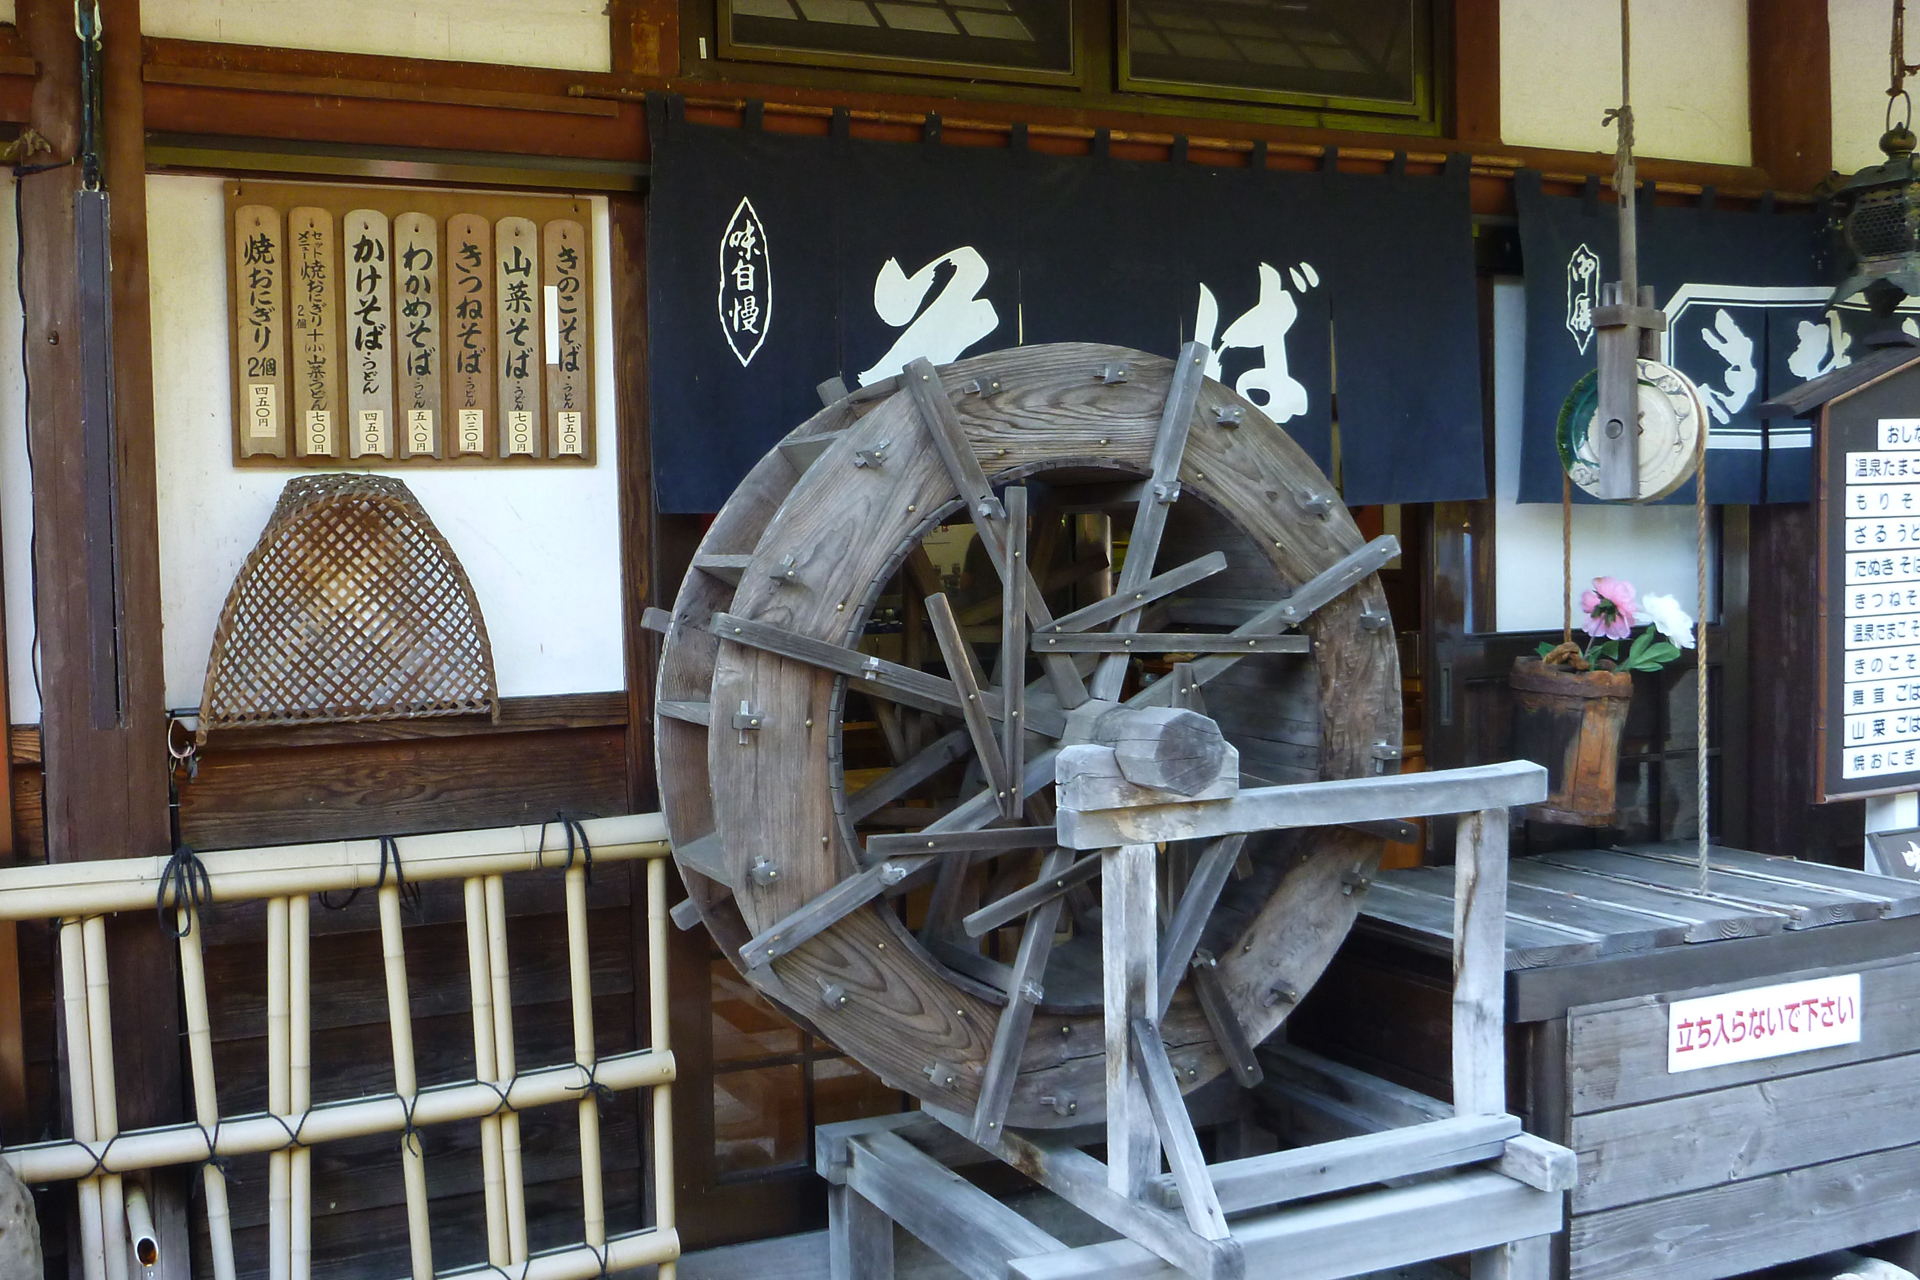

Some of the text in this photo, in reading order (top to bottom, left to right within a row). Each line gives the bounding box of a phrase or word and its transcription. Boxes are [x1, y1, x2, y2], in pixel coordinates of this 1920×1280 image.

[244, 233, 277, 378] 焼おにぎり 2個
[729, 218, 760, 334] 味自慢
[1676, 996, 1854, 1053] 立ち入らないで下さい
